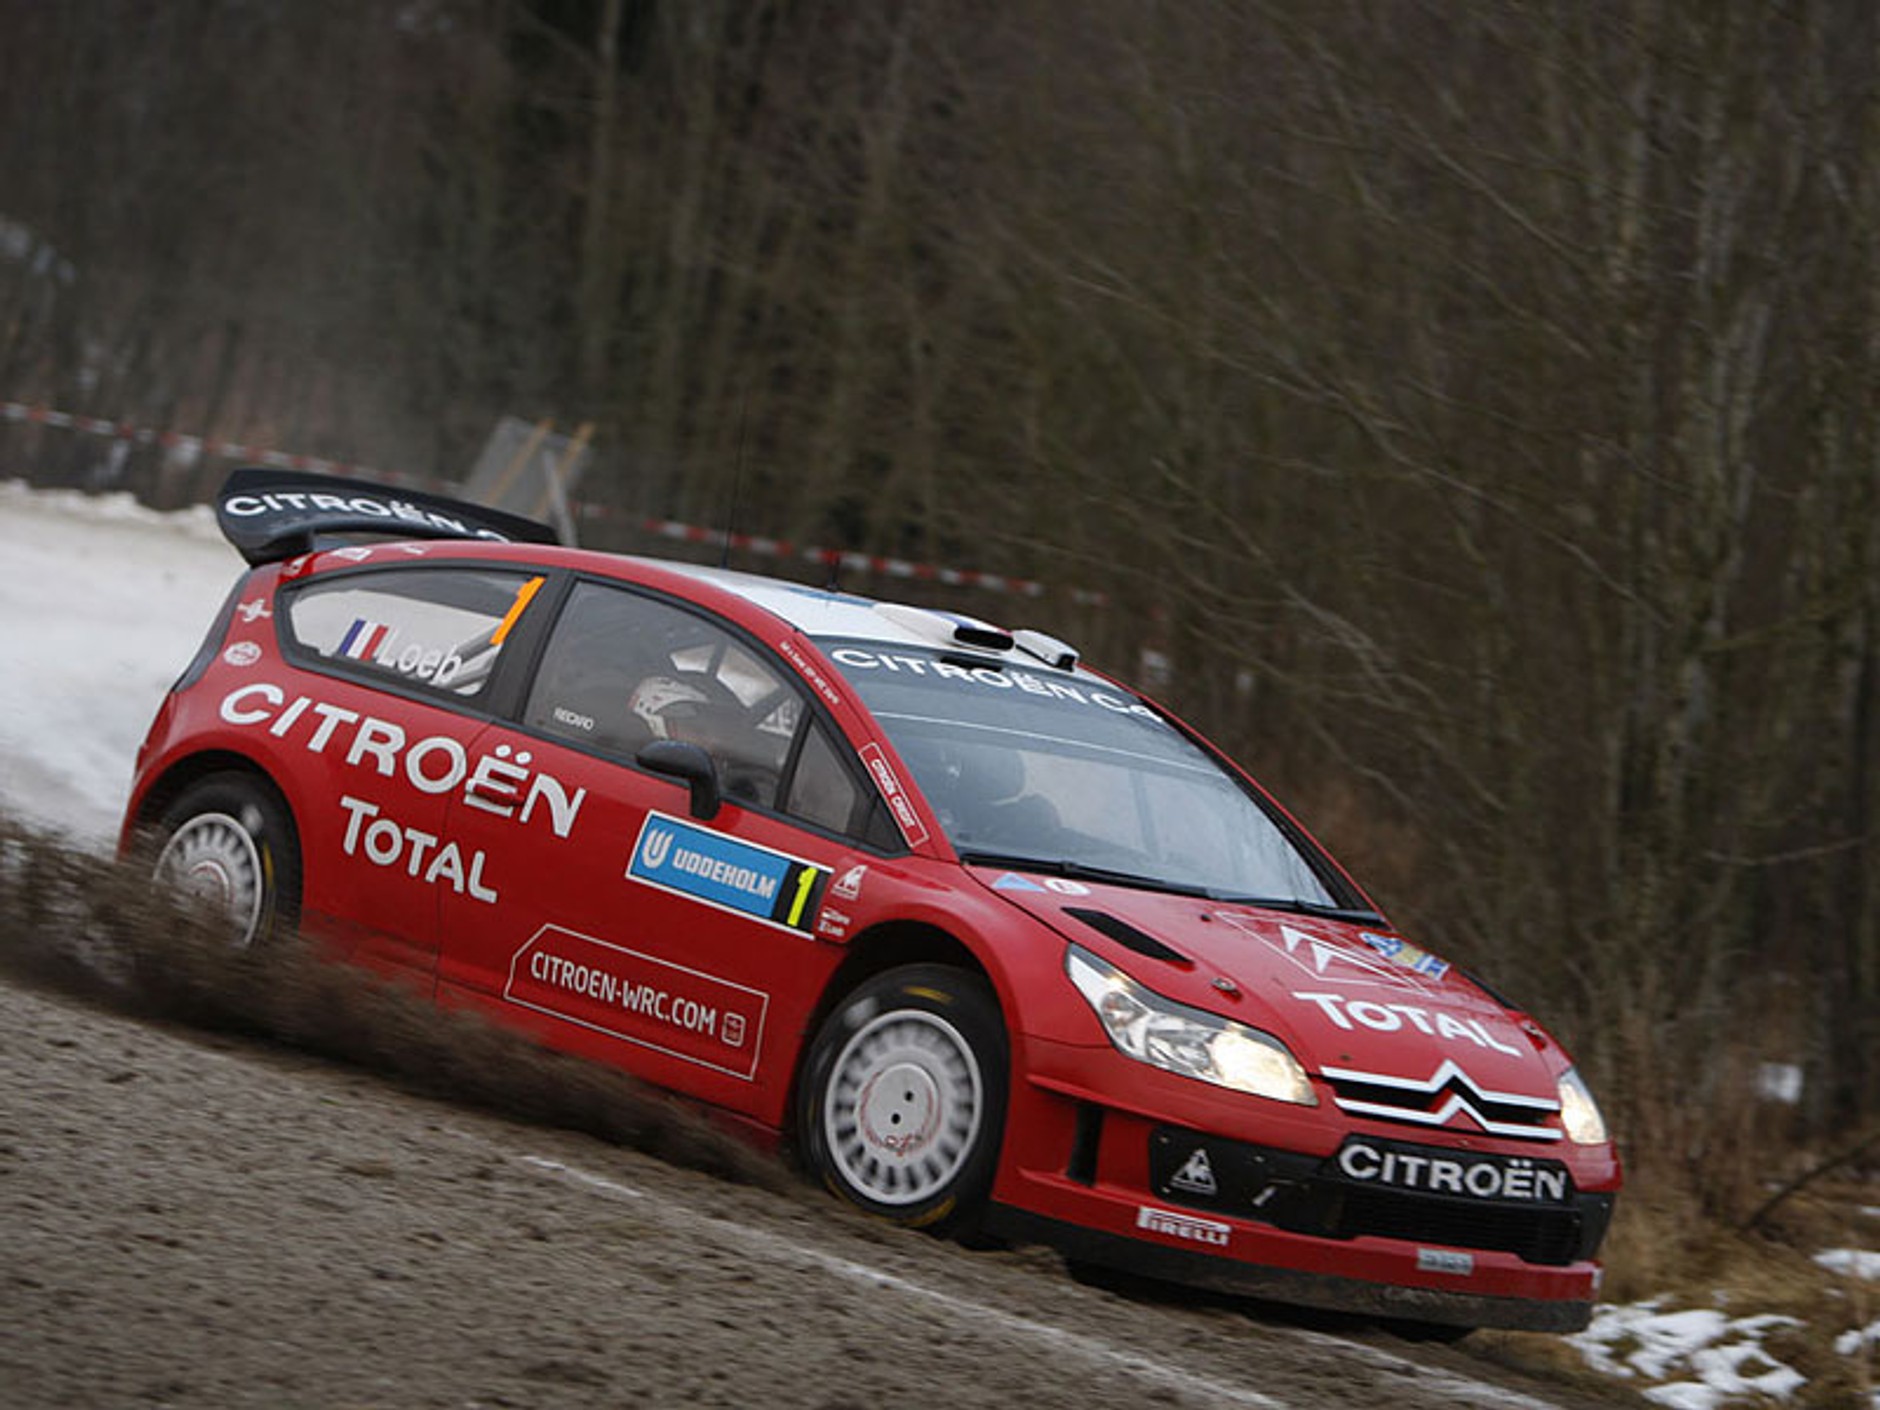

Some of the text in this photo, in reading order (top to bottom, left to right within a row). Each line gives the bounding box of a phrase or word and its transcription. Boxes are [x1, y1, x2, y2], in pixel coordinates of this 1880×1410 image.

[831, 648, 1089, 705] CITROËN
[220, 683, 586, 838] CITROËN
[340, 795, 498, 904] TOTAL
[672, 847, 778, 899] UDDEHOLM
[787, 866, 819, 928] 1
[530, 951, 717, 1036] CITROEN-WRC.COM
[1292, 991, 1522, 1057] TOTAL
[1338, 1143, 1567, 1200] CITROËN
